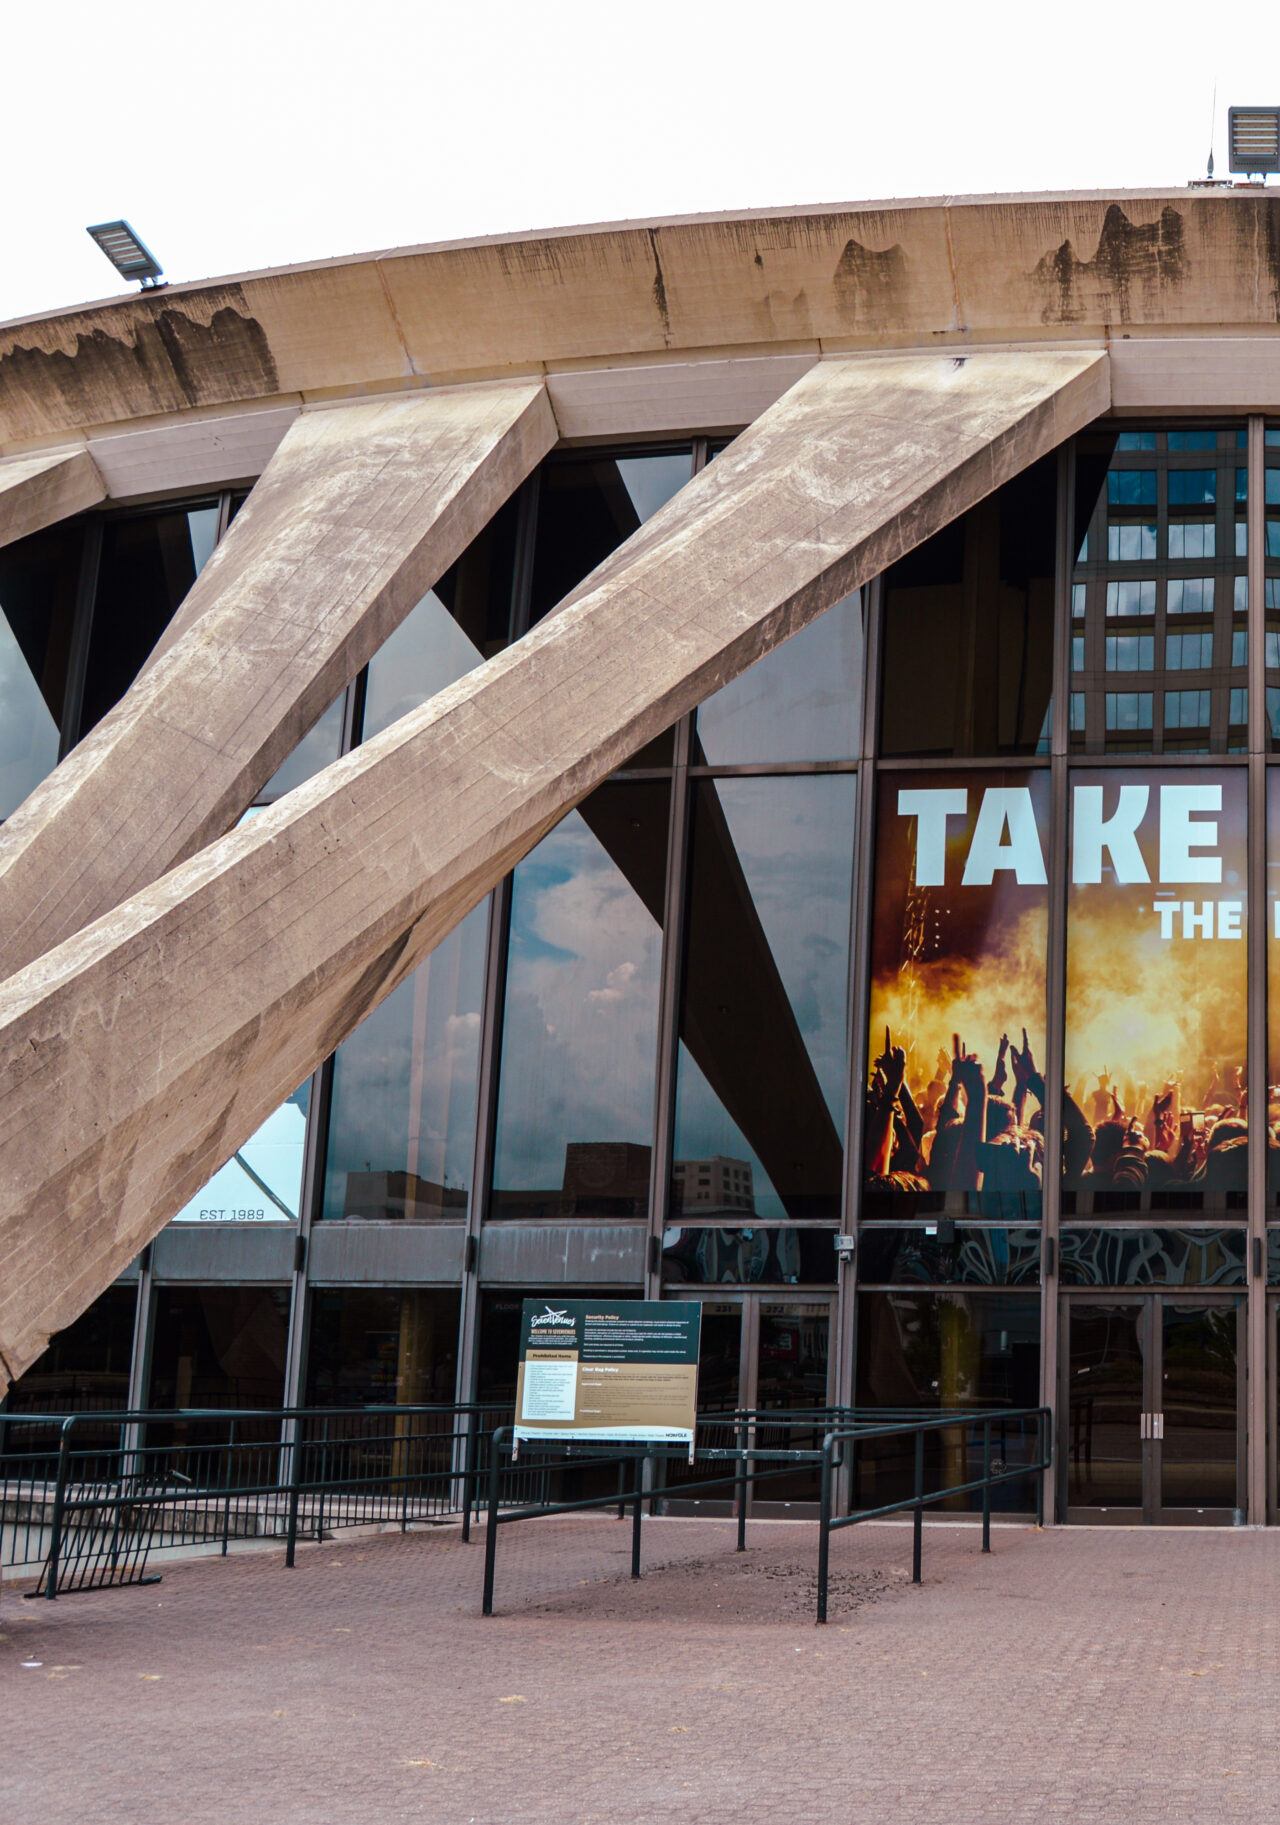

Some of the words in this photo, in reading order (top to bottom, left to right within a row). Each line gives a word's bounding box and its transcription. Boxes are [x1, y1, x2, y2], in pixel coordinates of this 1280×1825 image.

[897, 784, 1222, 887] TAKE
[1154, 900, 1243, 939] THE
[231, 1209, 265, 1220] 1989
